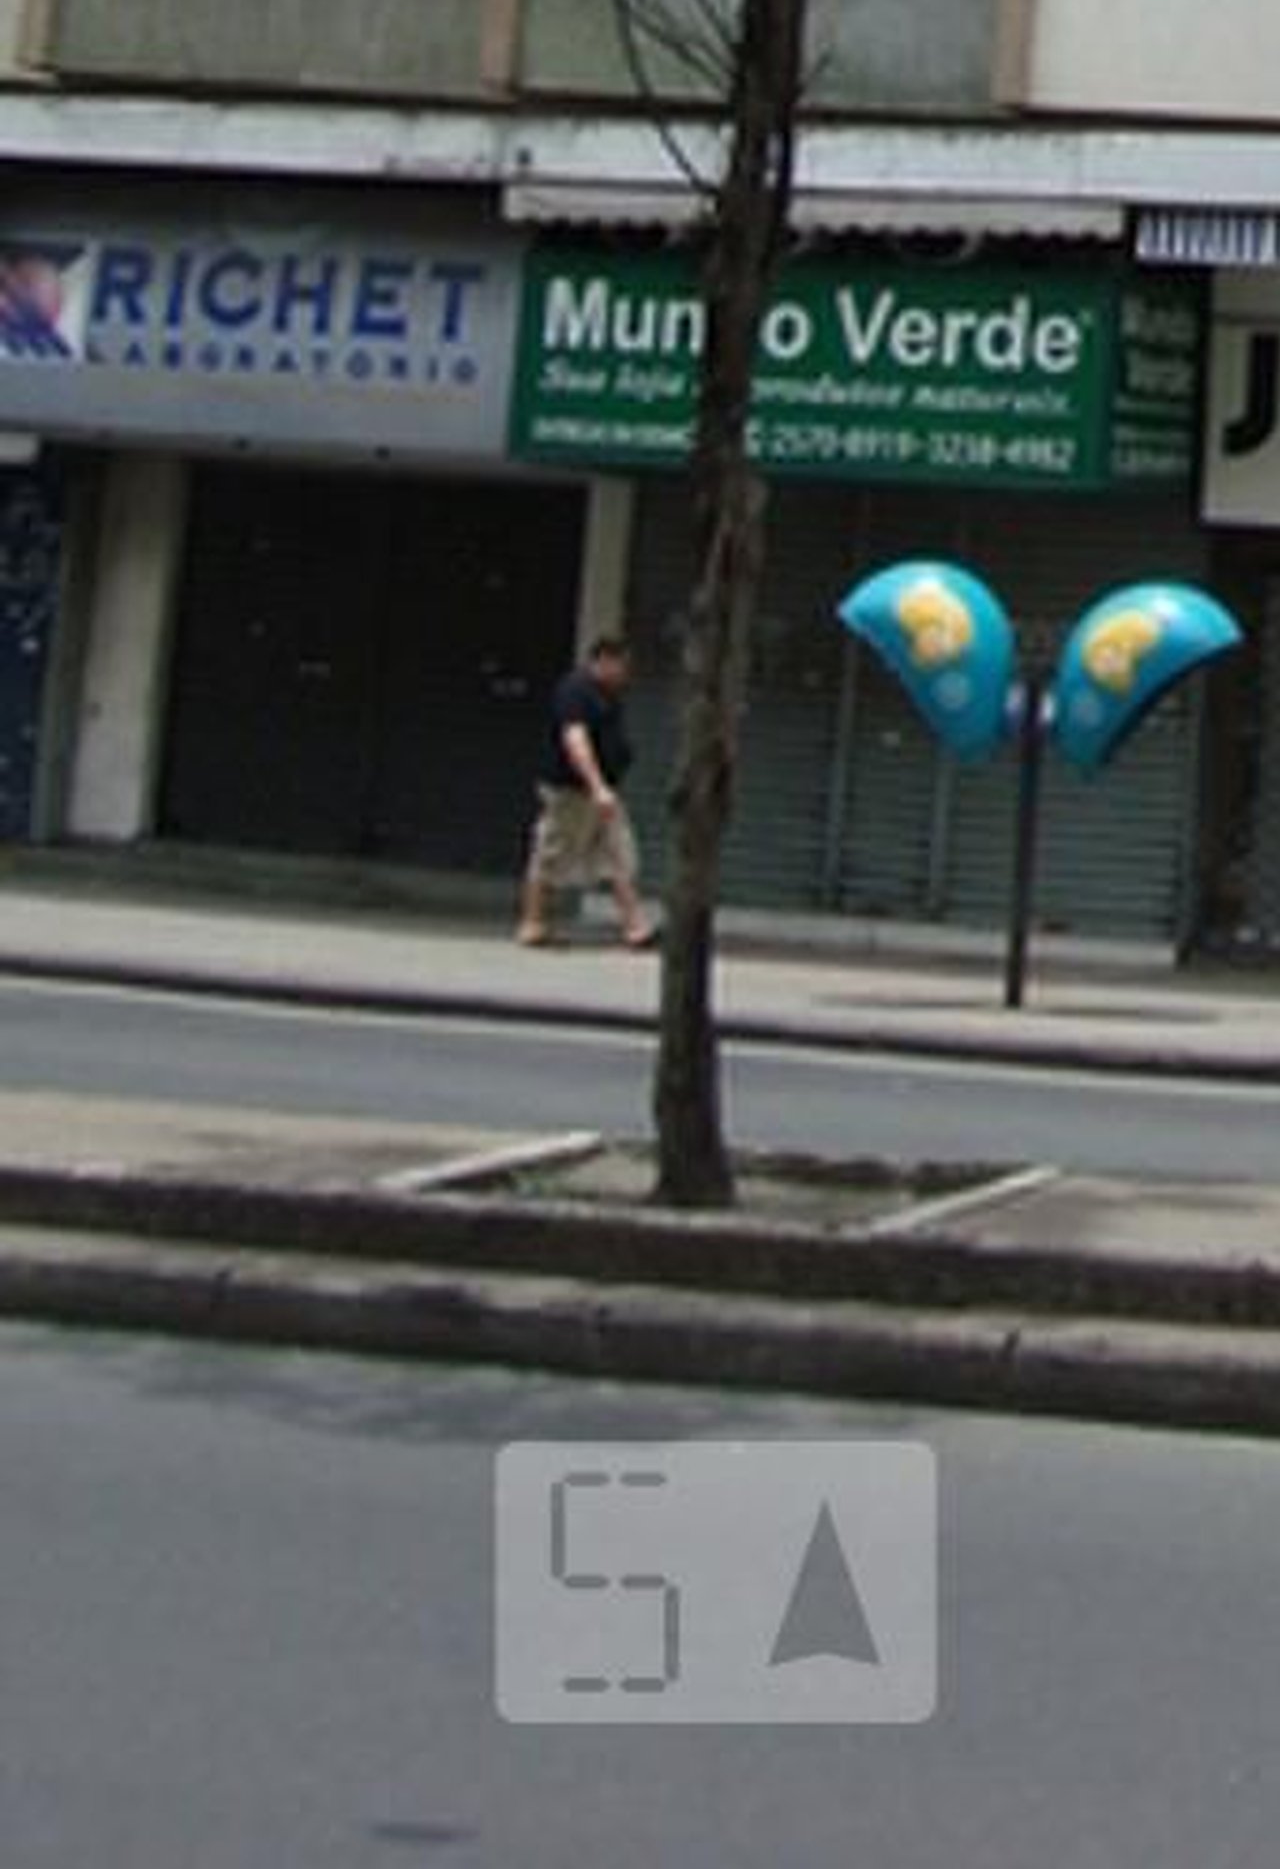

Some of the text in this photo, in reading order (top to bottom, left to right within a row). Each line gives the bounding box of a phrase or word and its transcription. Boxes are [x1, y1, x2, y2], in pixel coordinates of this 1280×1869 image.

[90, 245, 484, 342] RICHET
[543, 276, 812, 360] Muno
[834, 285, 1081, 373] Verde
